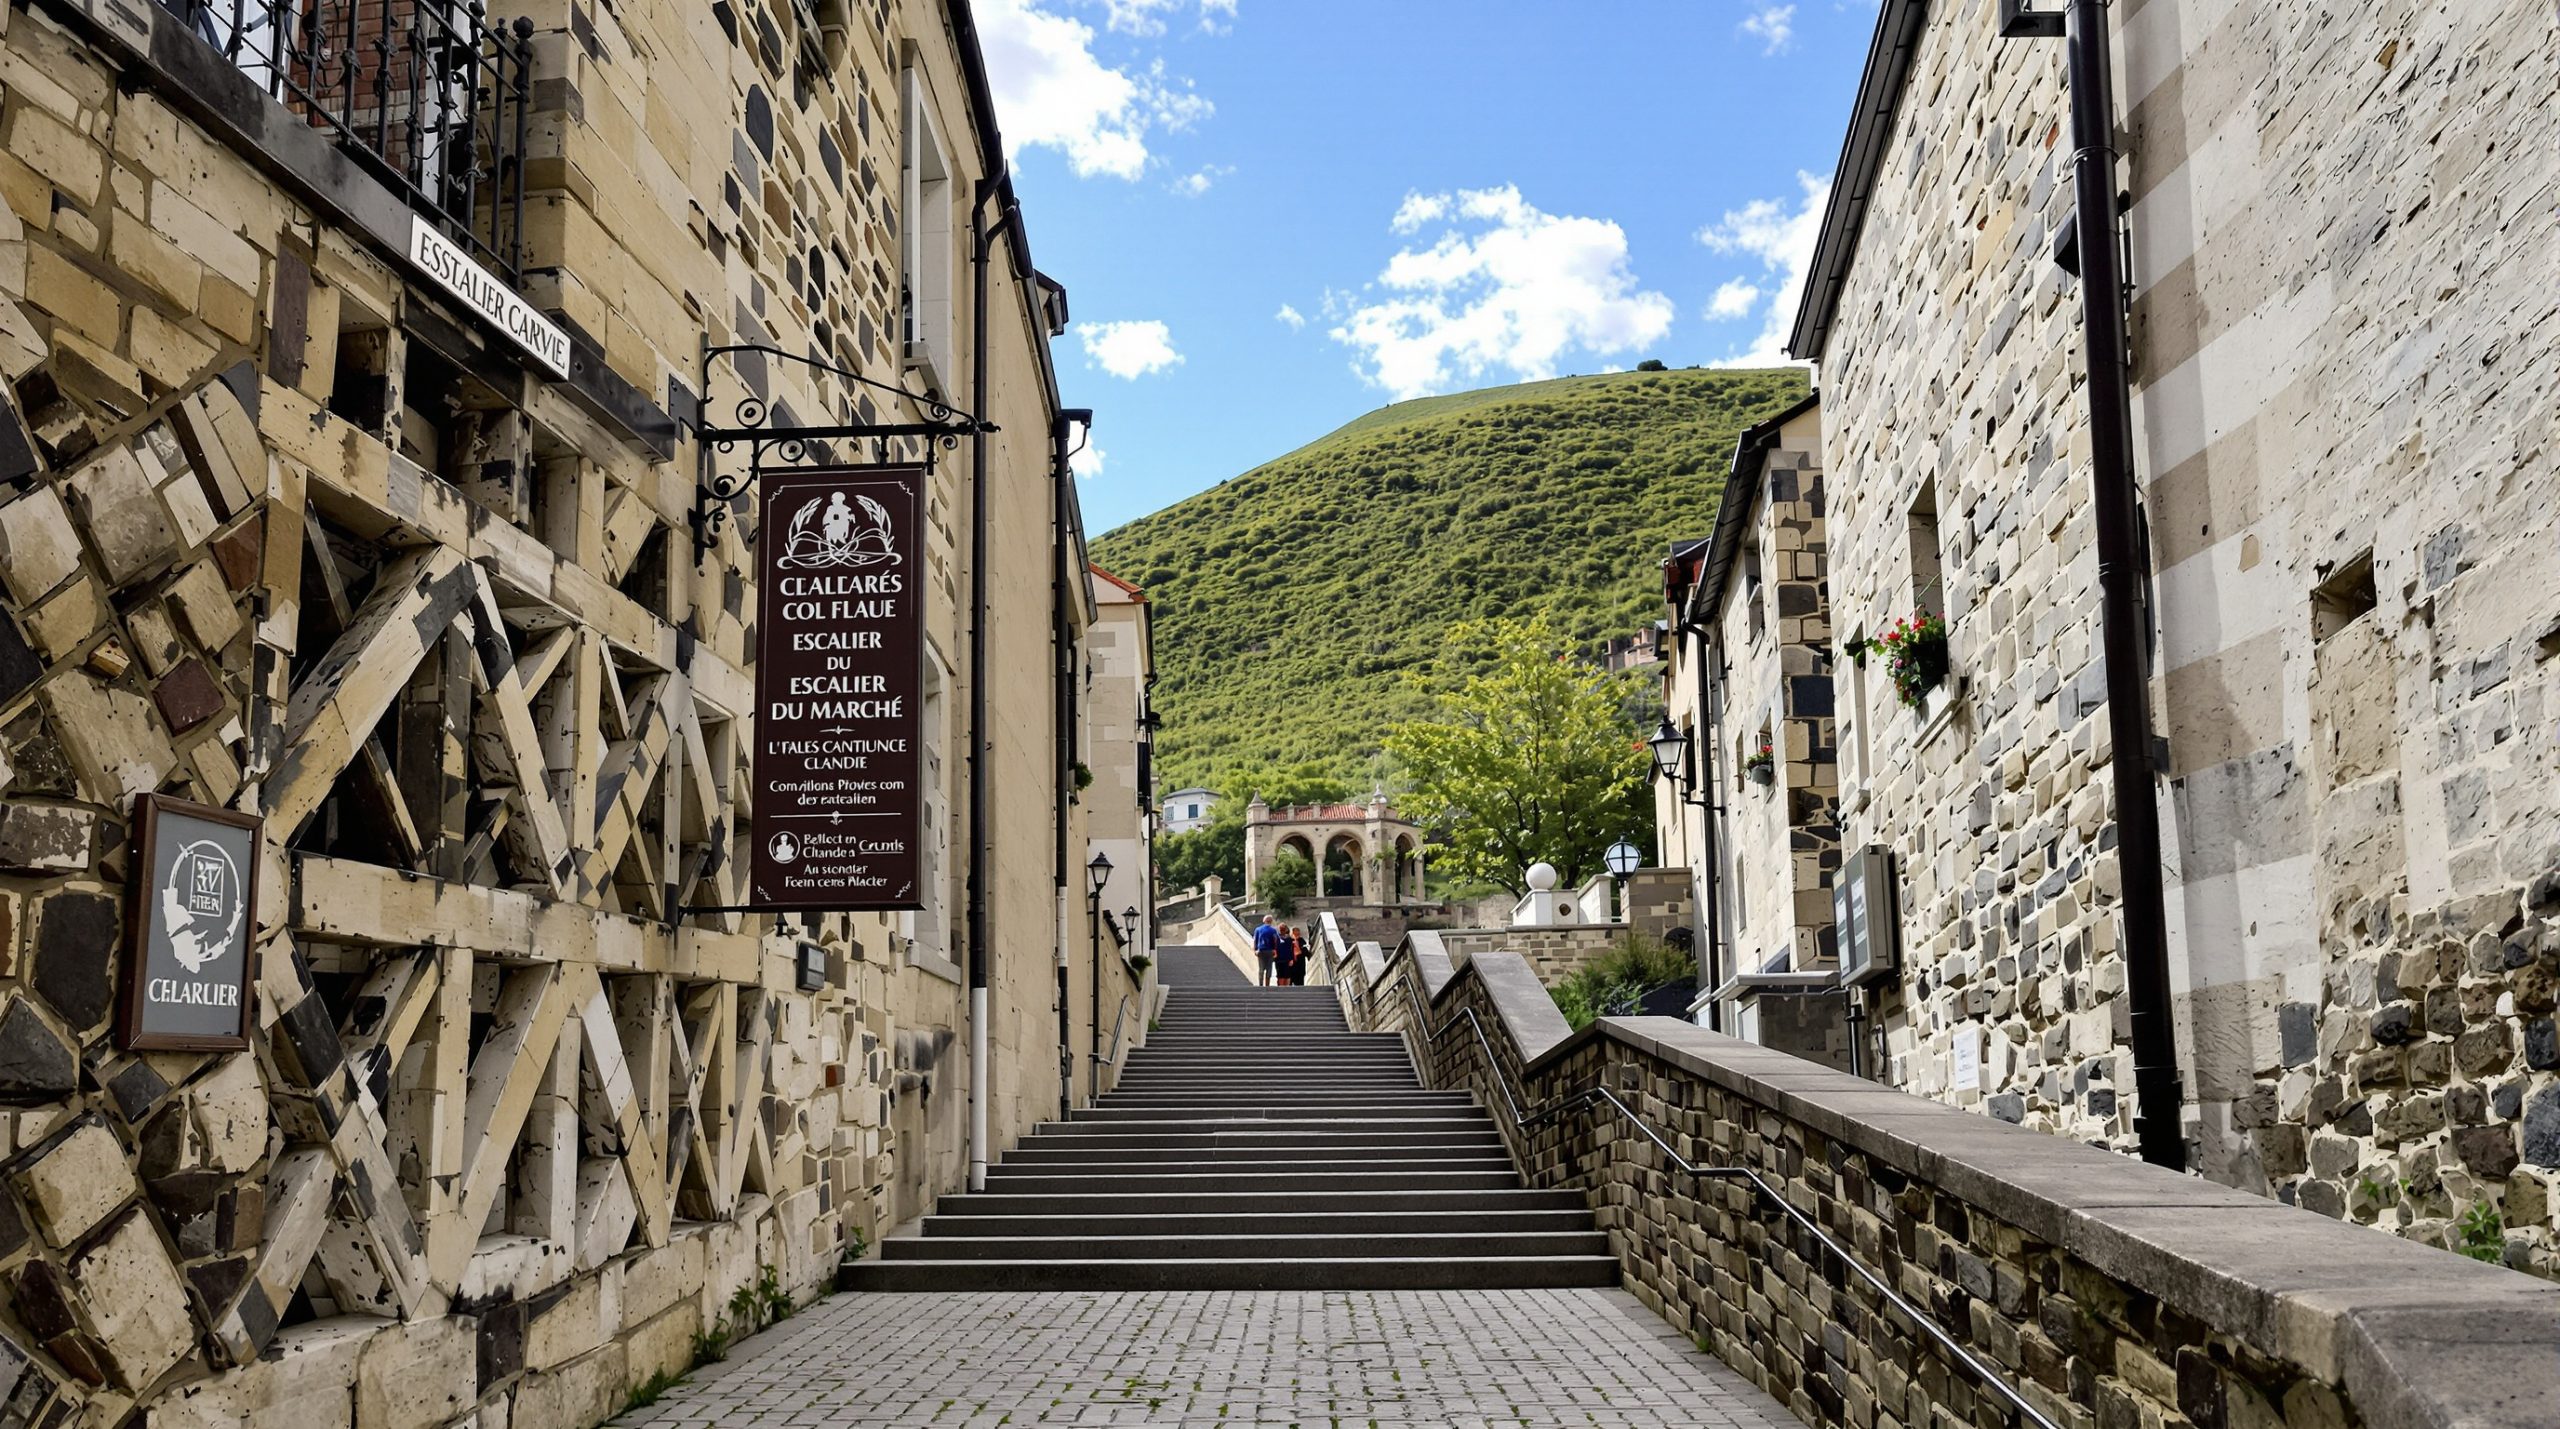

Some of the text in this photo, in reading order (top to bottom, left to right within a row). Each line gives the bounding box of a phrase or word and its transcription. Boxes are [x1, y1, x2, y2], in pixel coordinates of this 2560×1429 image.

[782, 601, 826, 621] COL
[793, 631, 882, 651] ESCALIER
[827, 656, 851, 671] DU
[790, 675, 887, 695] ESCALIER
[771, 695, 903, 721] DU MARCHÉ
